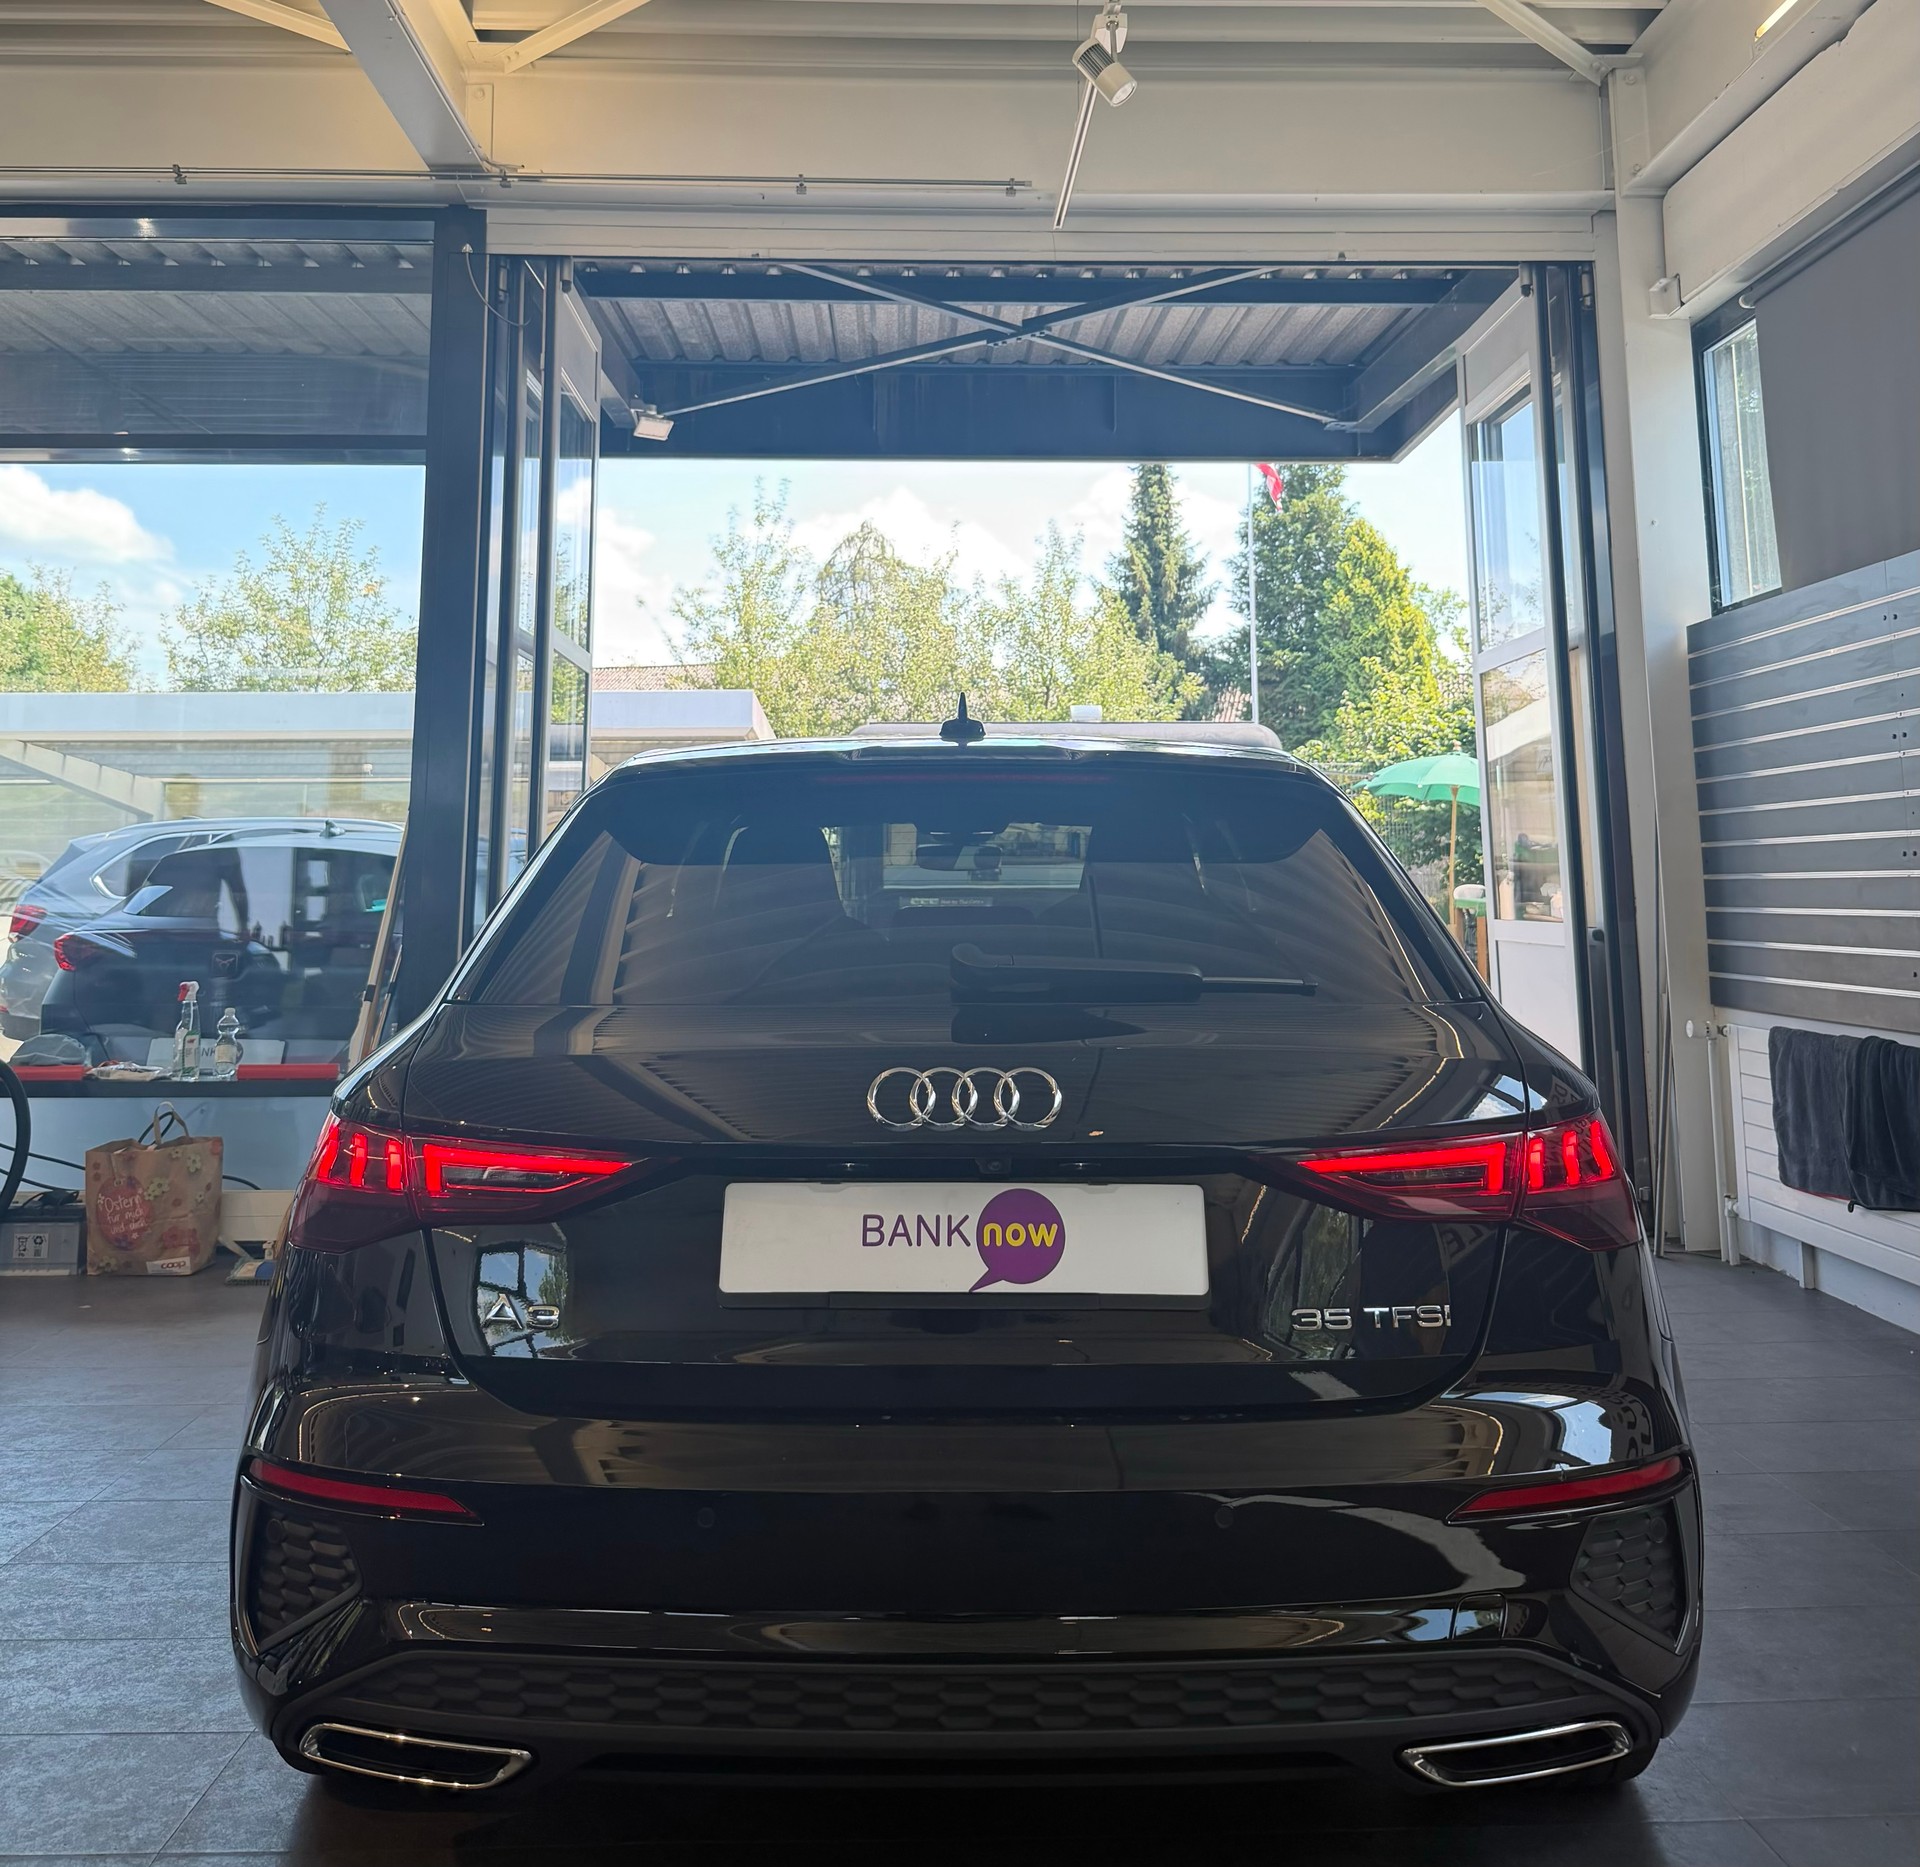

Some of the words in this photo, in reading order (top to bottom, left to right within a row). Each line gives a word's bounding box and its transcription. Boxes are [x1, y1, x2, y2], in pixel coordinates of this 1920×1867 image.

[105, 1194, 141, 1213] Ostern
[861, 1214, 971, 1248] BANK
[983, 1222, 1059, 1248] now
[160, 1260, 186, 1270] coop
[480, 1293, 560, 1329] A3
[1292, 1308, 1353, 1331] 35
[1363, 1305, 1451, 1329] TFSI
